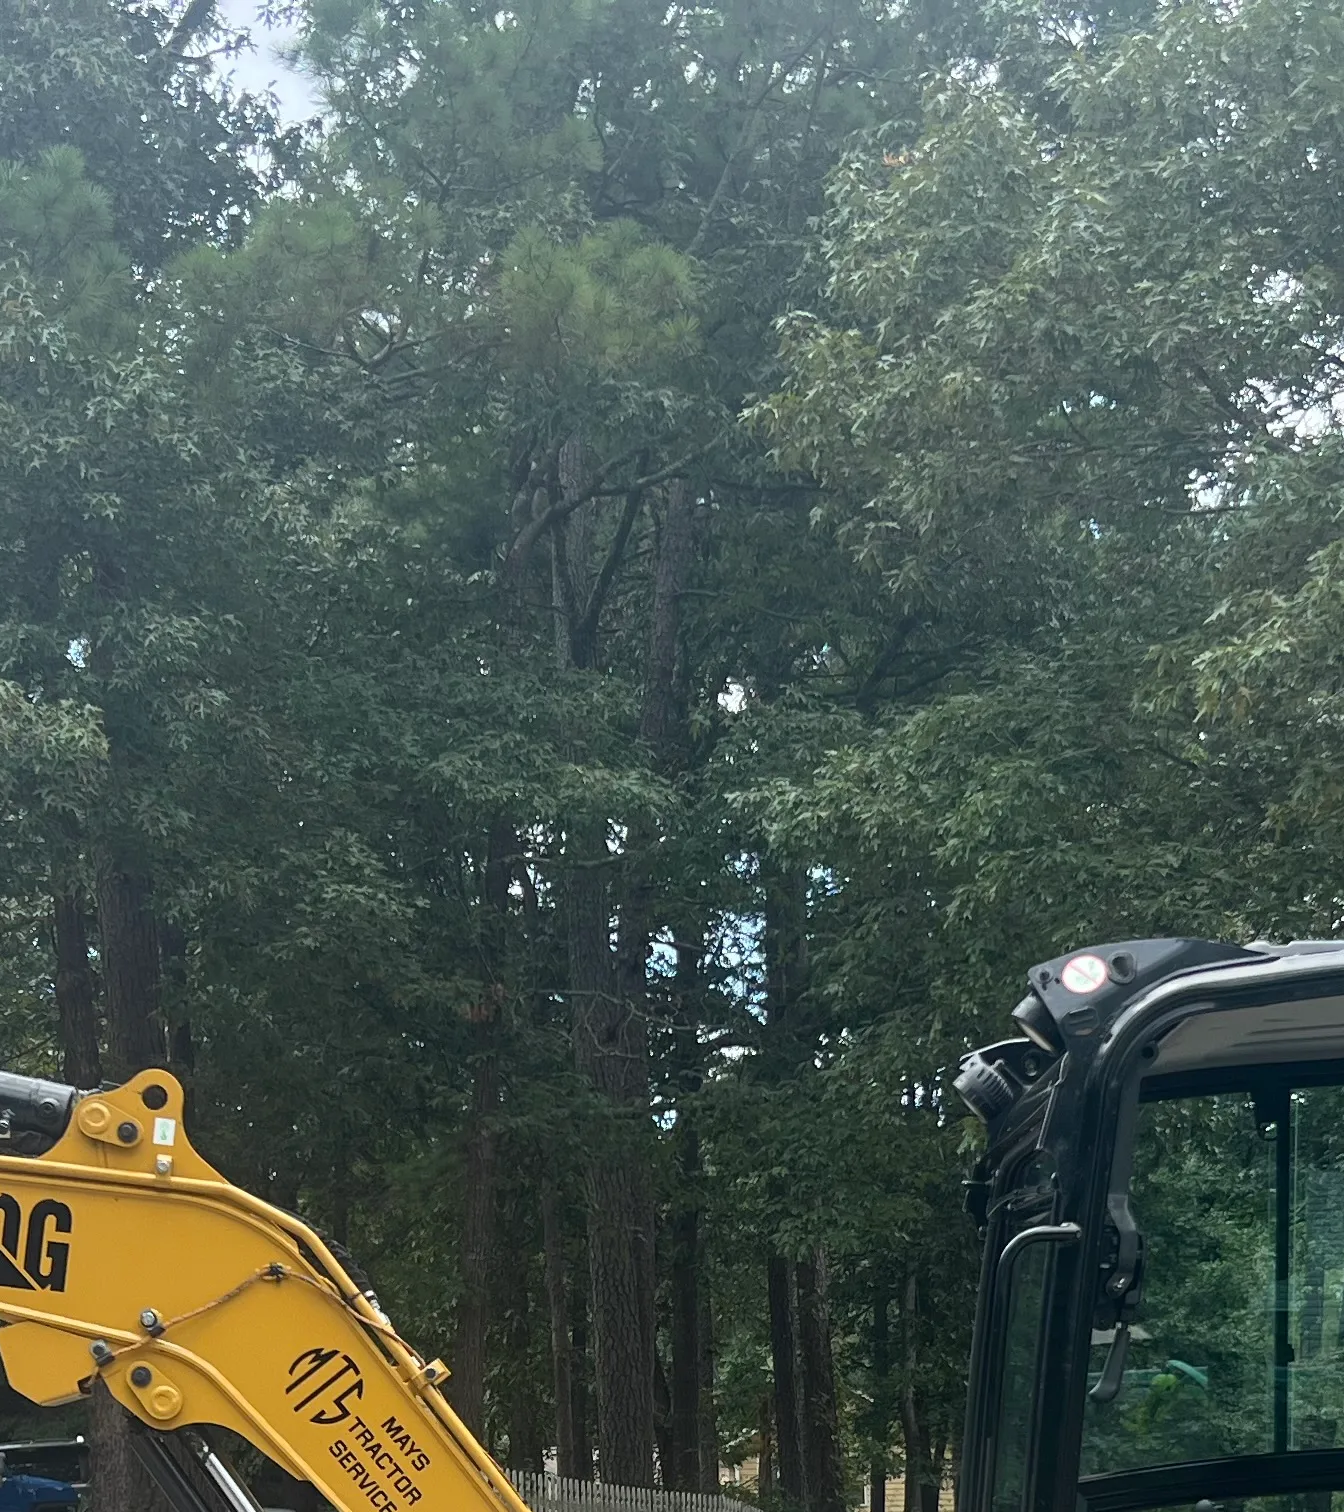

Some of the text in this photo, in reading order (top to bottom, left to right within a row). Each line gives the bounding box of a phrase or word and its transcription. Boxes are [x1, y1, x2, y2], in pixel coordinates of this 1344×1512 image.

[285, 1347, 364, 1425] MTS
[348, 1416, 423, 1506] TRACTOR
[380, 1415, 431, 1472] MAYS
